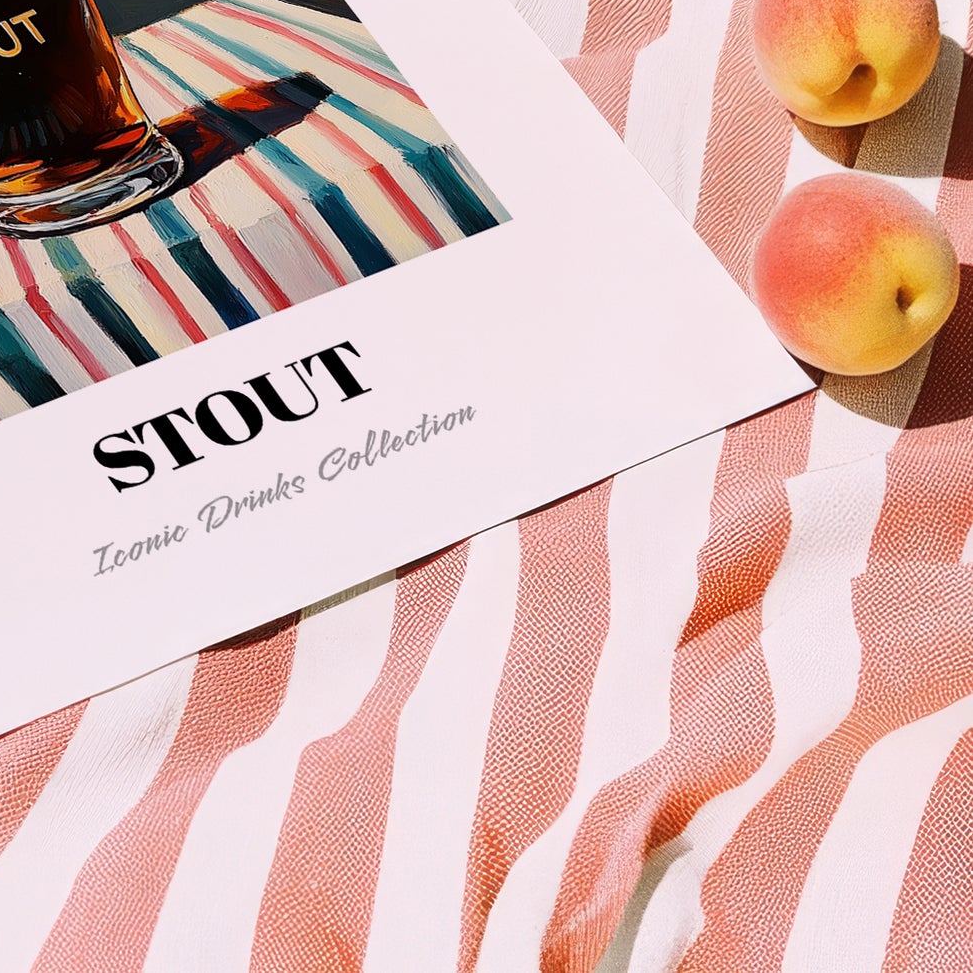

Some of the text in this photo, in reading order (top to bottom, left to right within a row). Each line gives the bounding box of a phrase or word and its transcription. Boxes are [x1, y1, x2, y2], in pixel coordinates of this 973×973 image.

[93, 340, 372, 493] STOUT
[93, 404, 477, 577] Iconic Drinks Collection
